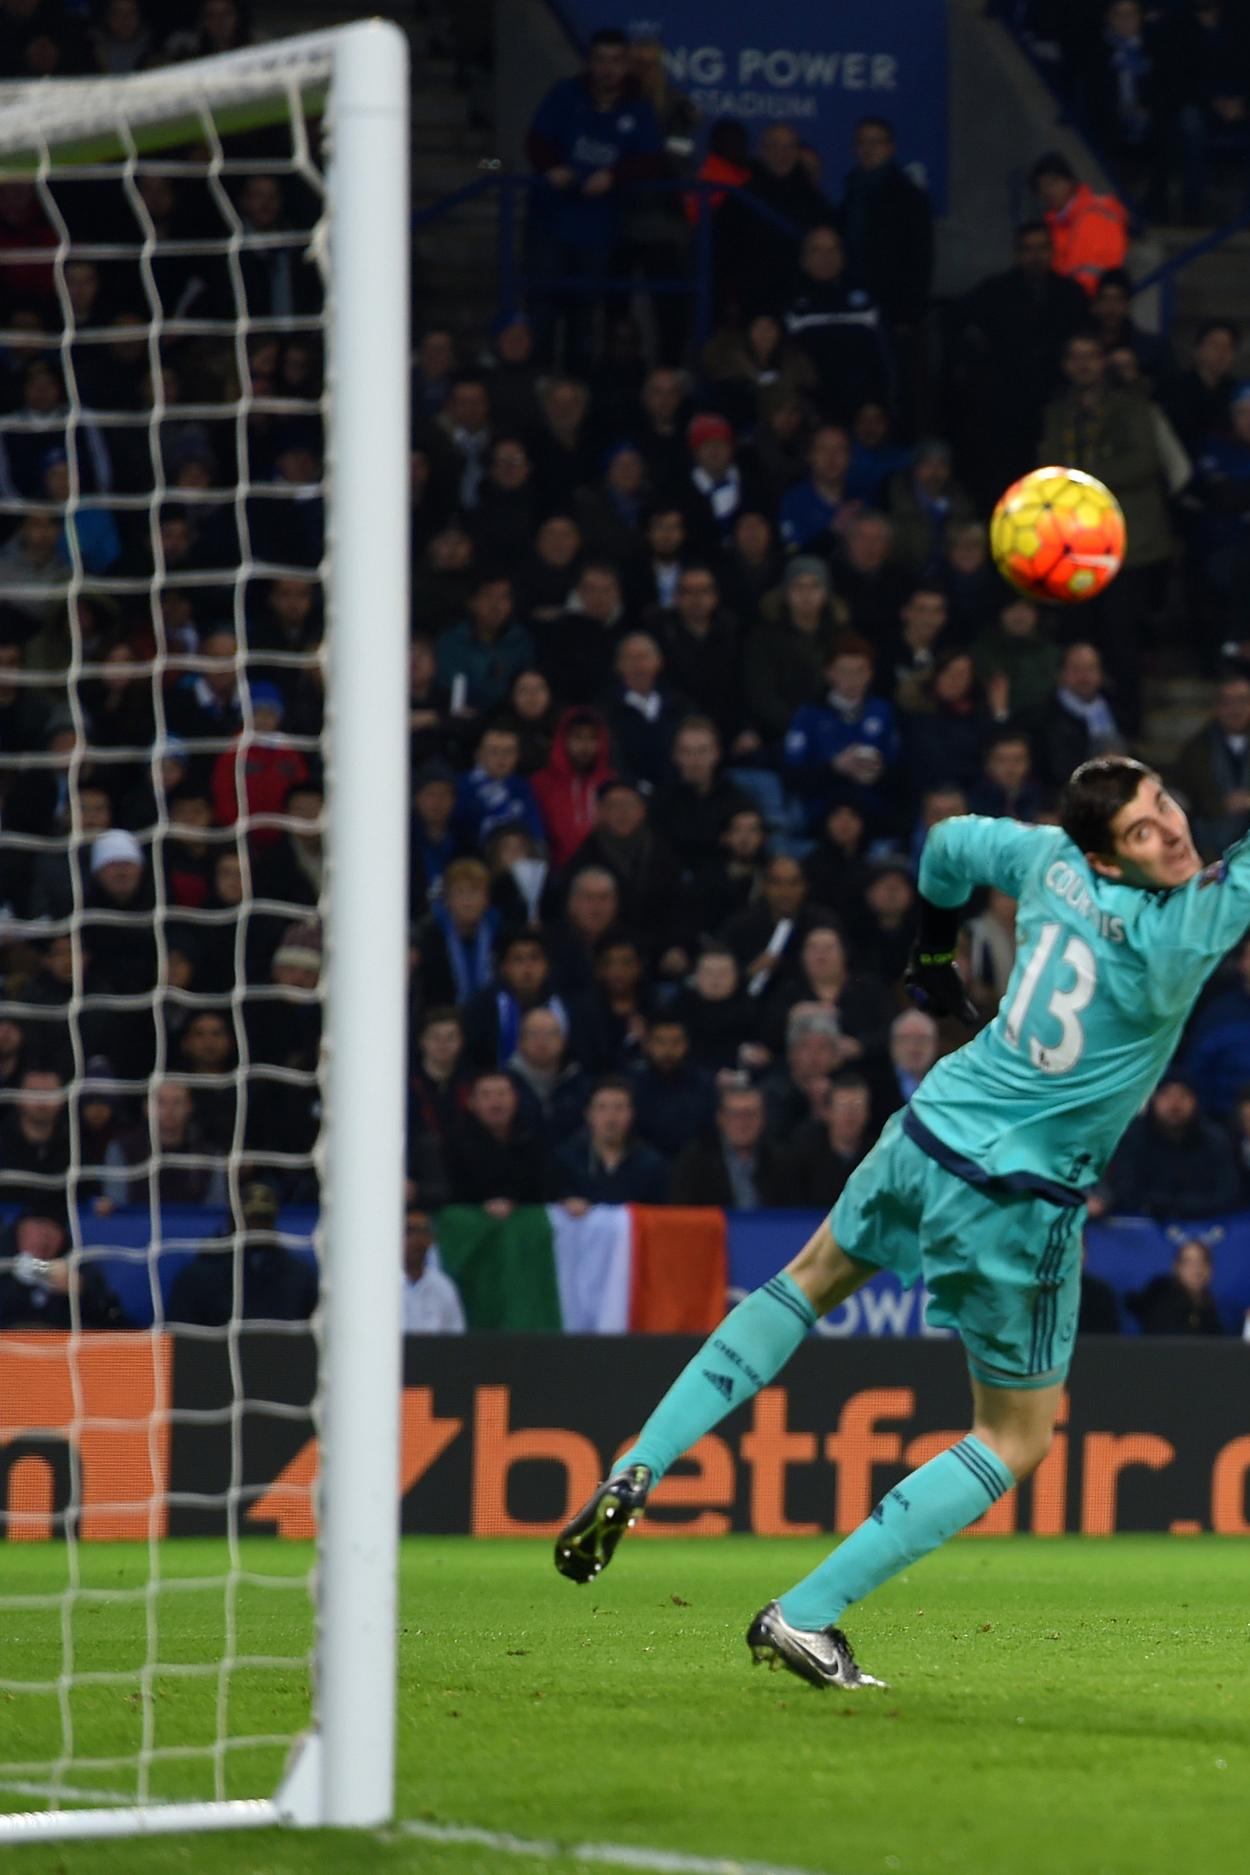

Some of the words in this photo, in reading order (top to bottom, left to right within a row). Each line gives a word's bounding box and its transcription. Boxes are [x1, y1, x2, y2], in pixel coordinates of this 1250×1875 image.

[660, 46, 726, 85] NG
[738, 48, 898, 90] POWER
[1004, 921, 1097, 1075] 13
